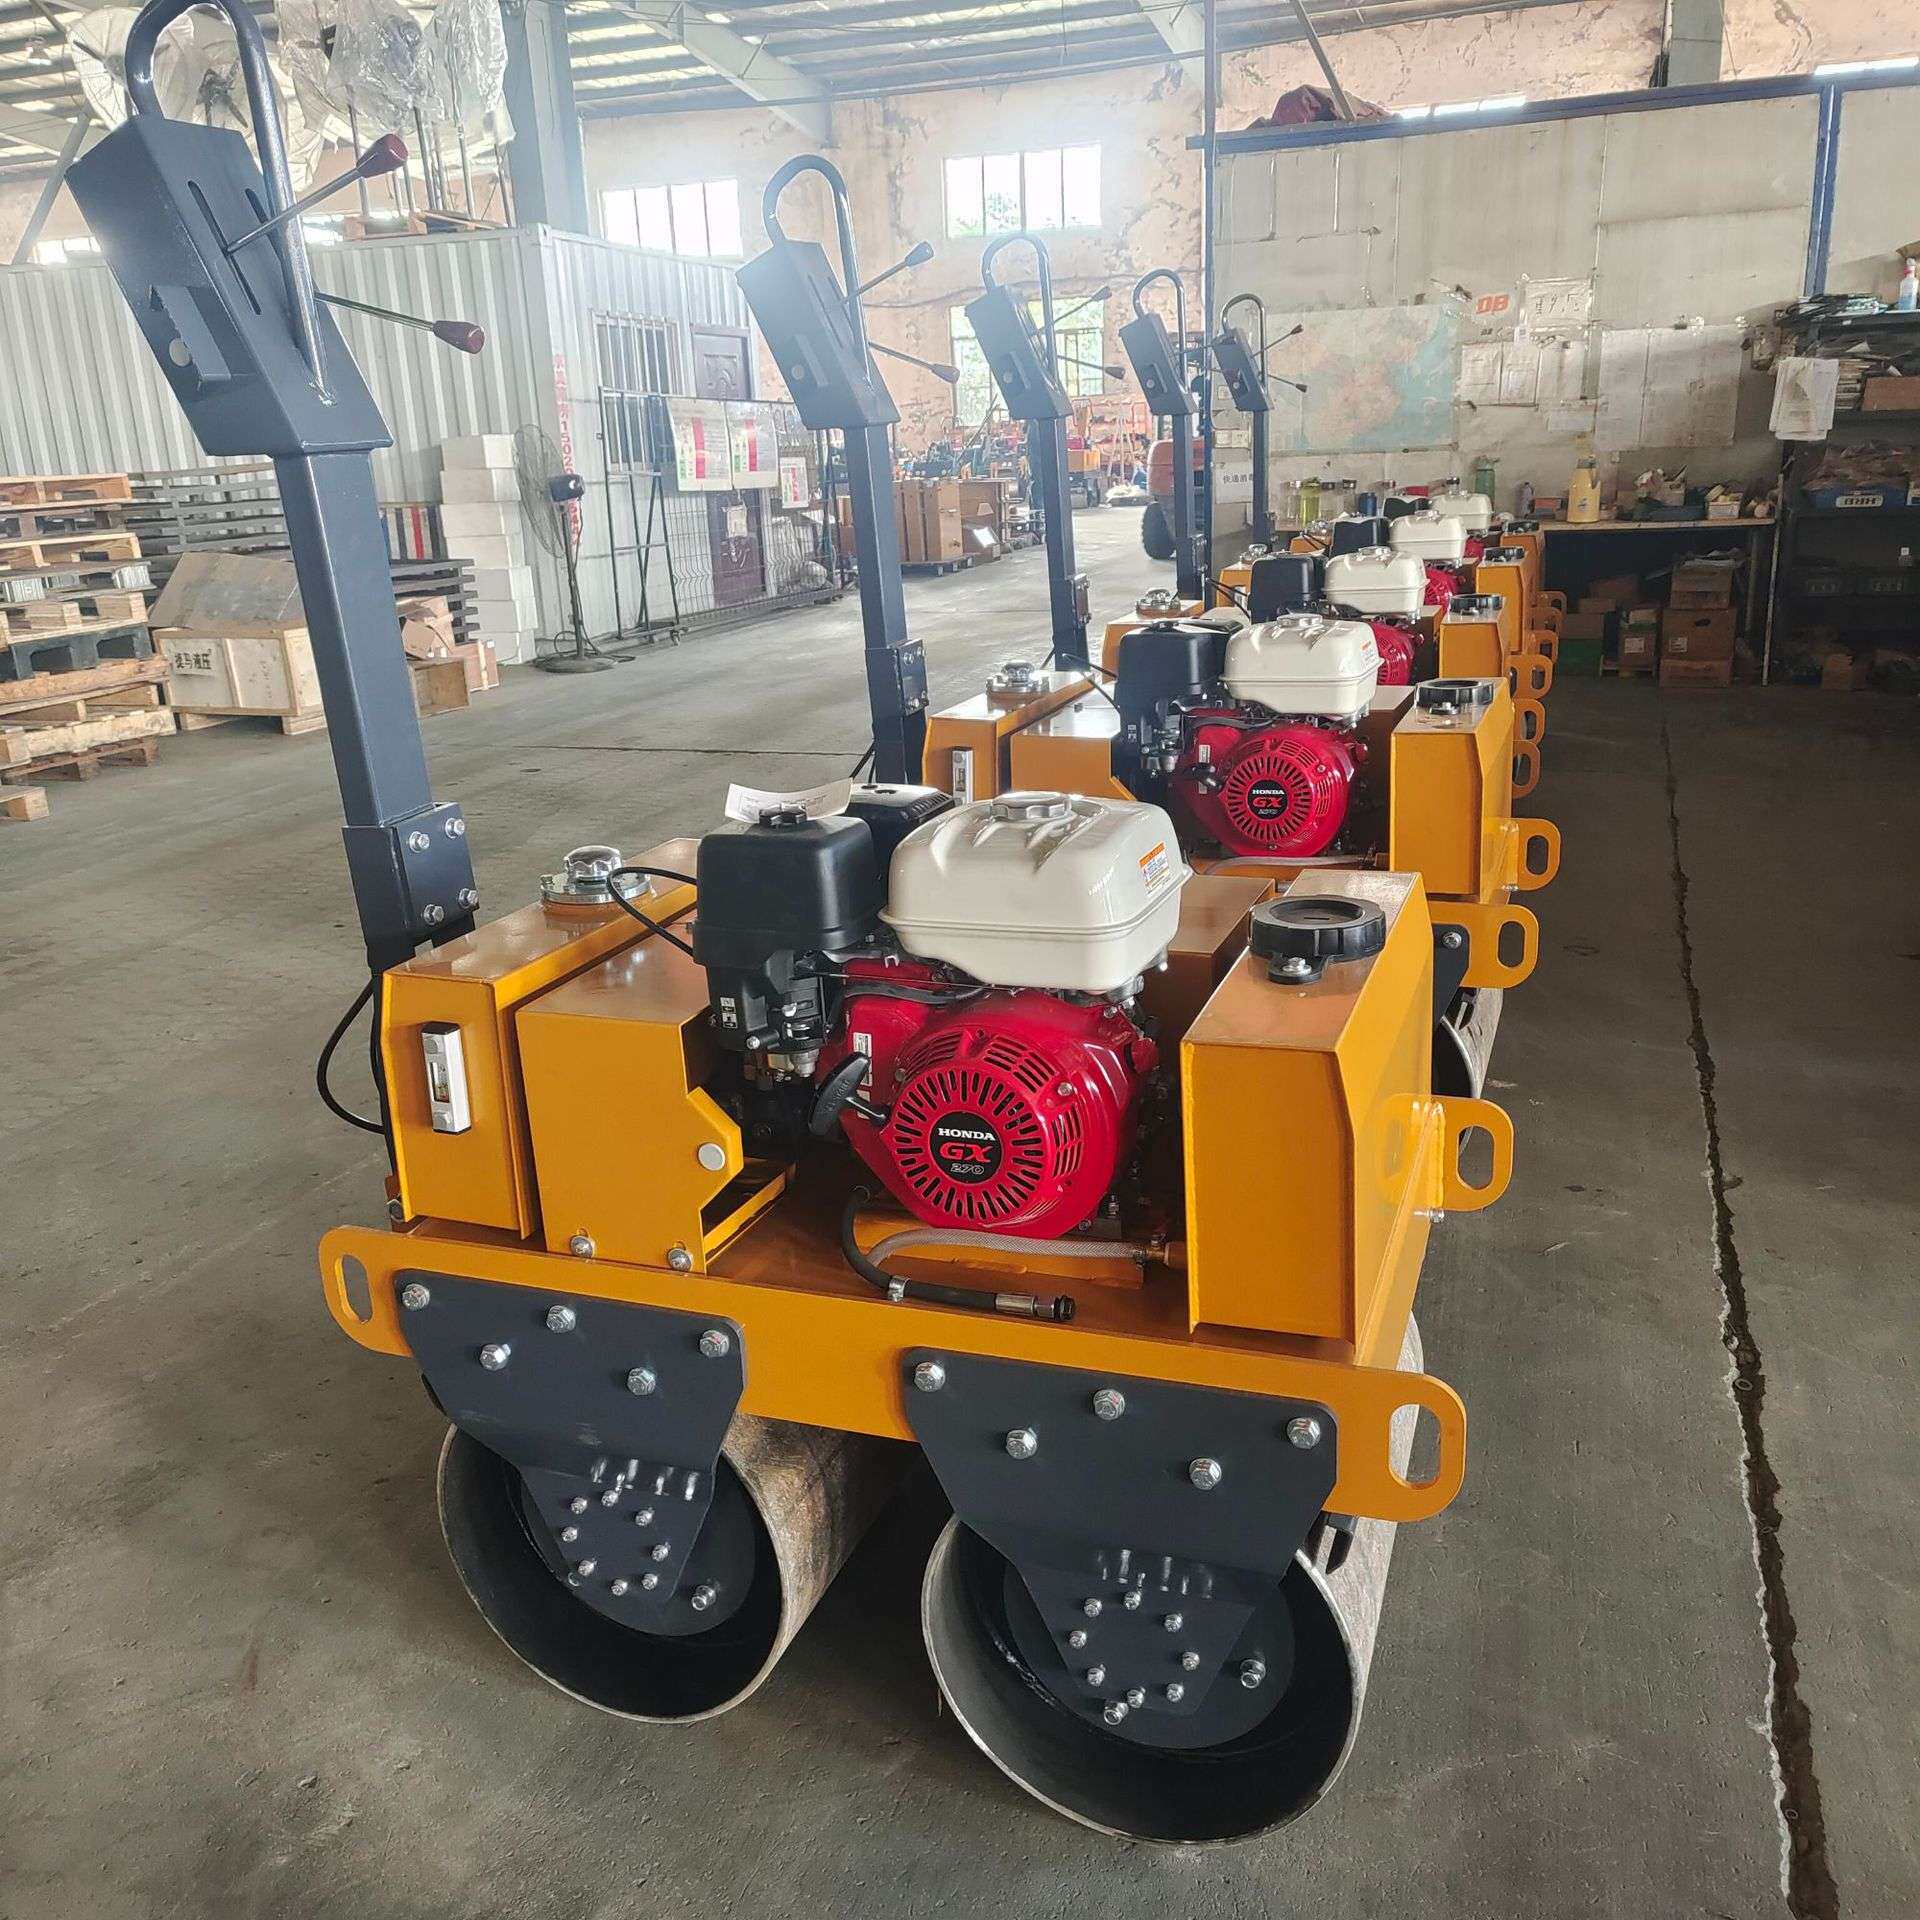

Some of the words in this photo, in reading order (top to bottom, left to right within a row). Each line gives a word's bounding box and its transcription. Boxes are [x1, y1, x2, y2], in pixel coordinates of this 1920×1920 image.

[1252, 796, 1283, 808] GX
[938, 1127, 996, 1141] HONDA
[940, 1141, 994, 1163] GX
[950, 1163, 985, 1175] 270
